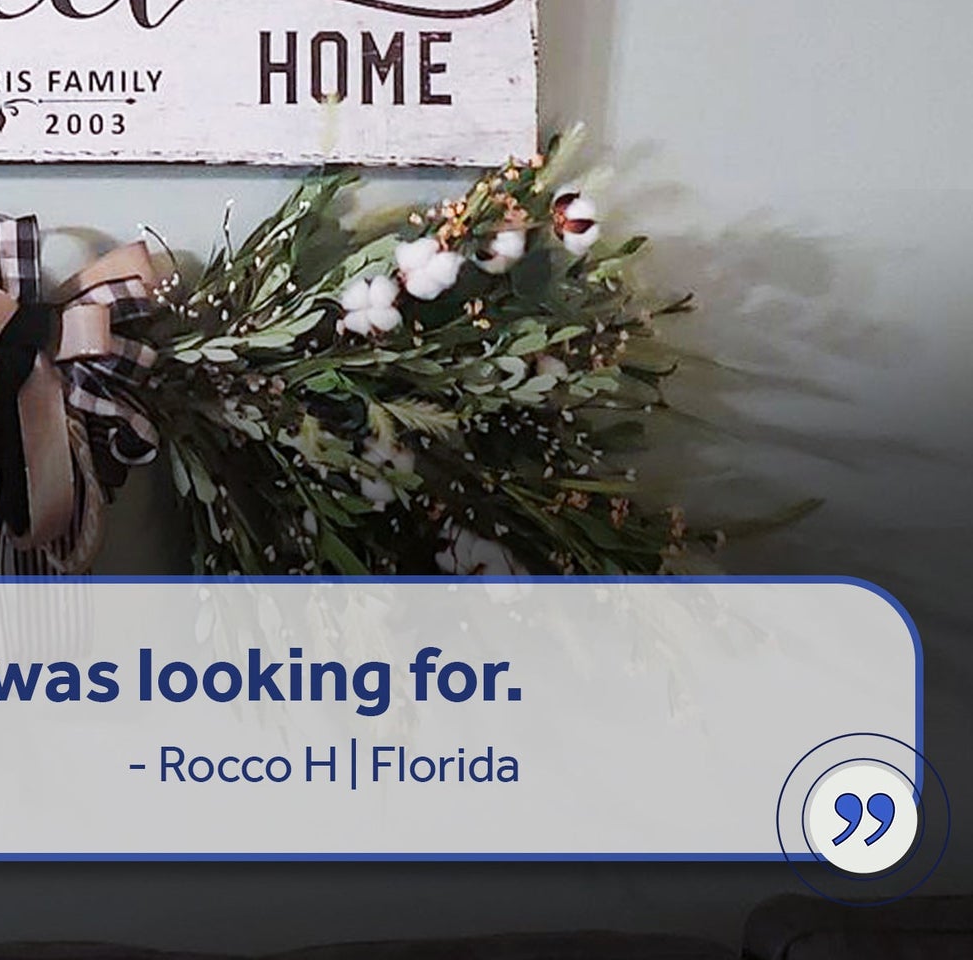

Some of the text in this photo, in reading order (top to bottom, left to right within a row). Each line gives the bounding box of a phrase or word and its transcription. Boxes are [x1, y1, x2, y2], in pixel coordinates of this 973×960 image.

[259, 31, 453, 105] HOME
[48, 70, 163, 92] FAMILY
[45, 113, 126, 135] 2003
